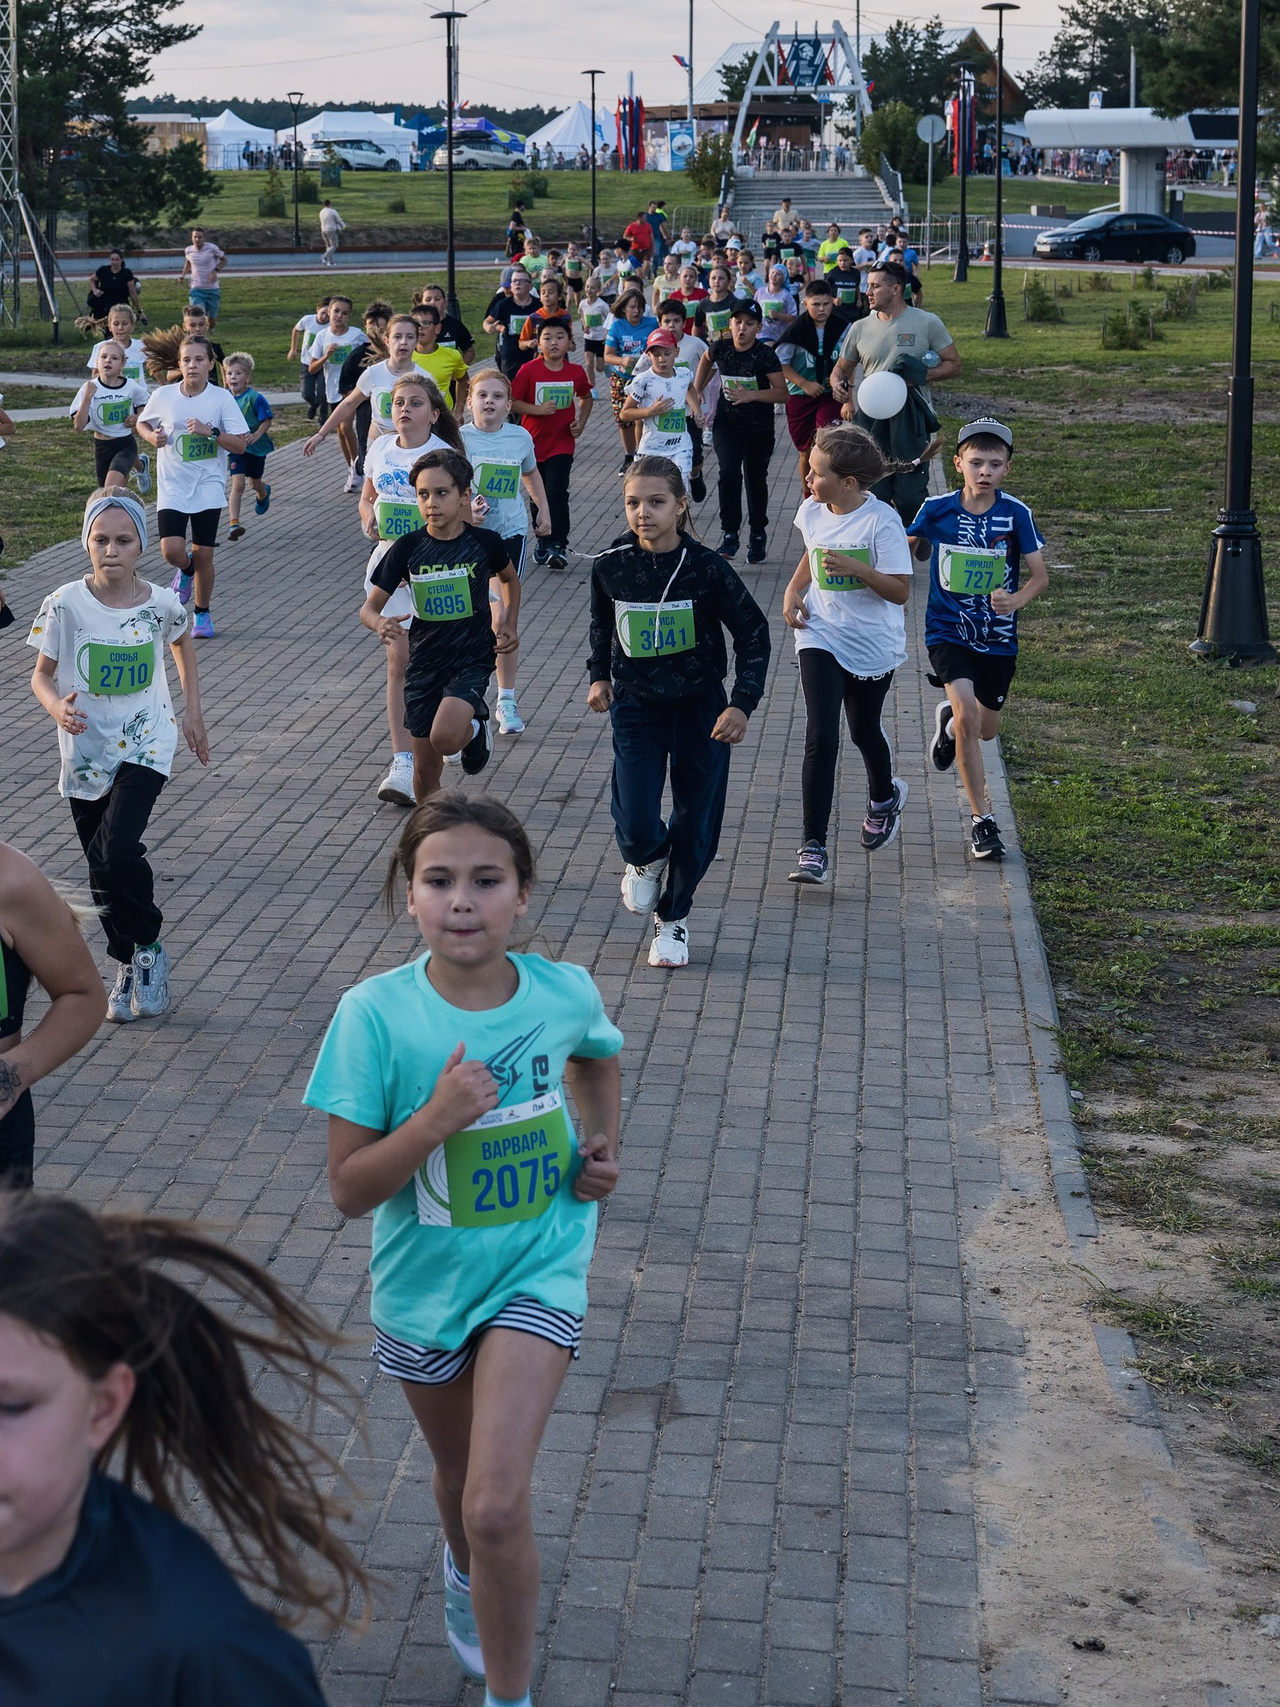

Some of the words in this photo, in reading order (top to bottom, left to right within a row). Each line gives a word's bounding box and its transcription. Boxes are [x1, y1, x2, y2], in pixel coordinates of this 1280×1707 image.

[189, 443, 214, 458] 2374
[486, 477, 516, 494] 4474
[393, 508, 412, 516] ДАРЬЯ
[386, 517, 419, 535] 2651
[965, 559, 994, 569] КИРИЛЛ
[964, 570, 994, 589] 727
[427, 584, 455, 595] СТЕПАН
[424, 594, 466, 616] 4895
[640, 628, 687, 651] 3041
[110, 652, 138, 662] СОФЬЯ
[100, 662, 148, 688] 2710
[481, 1129, 548, 1161] ВАРВАРА
[472, 1152, 561, 1213] 2075
